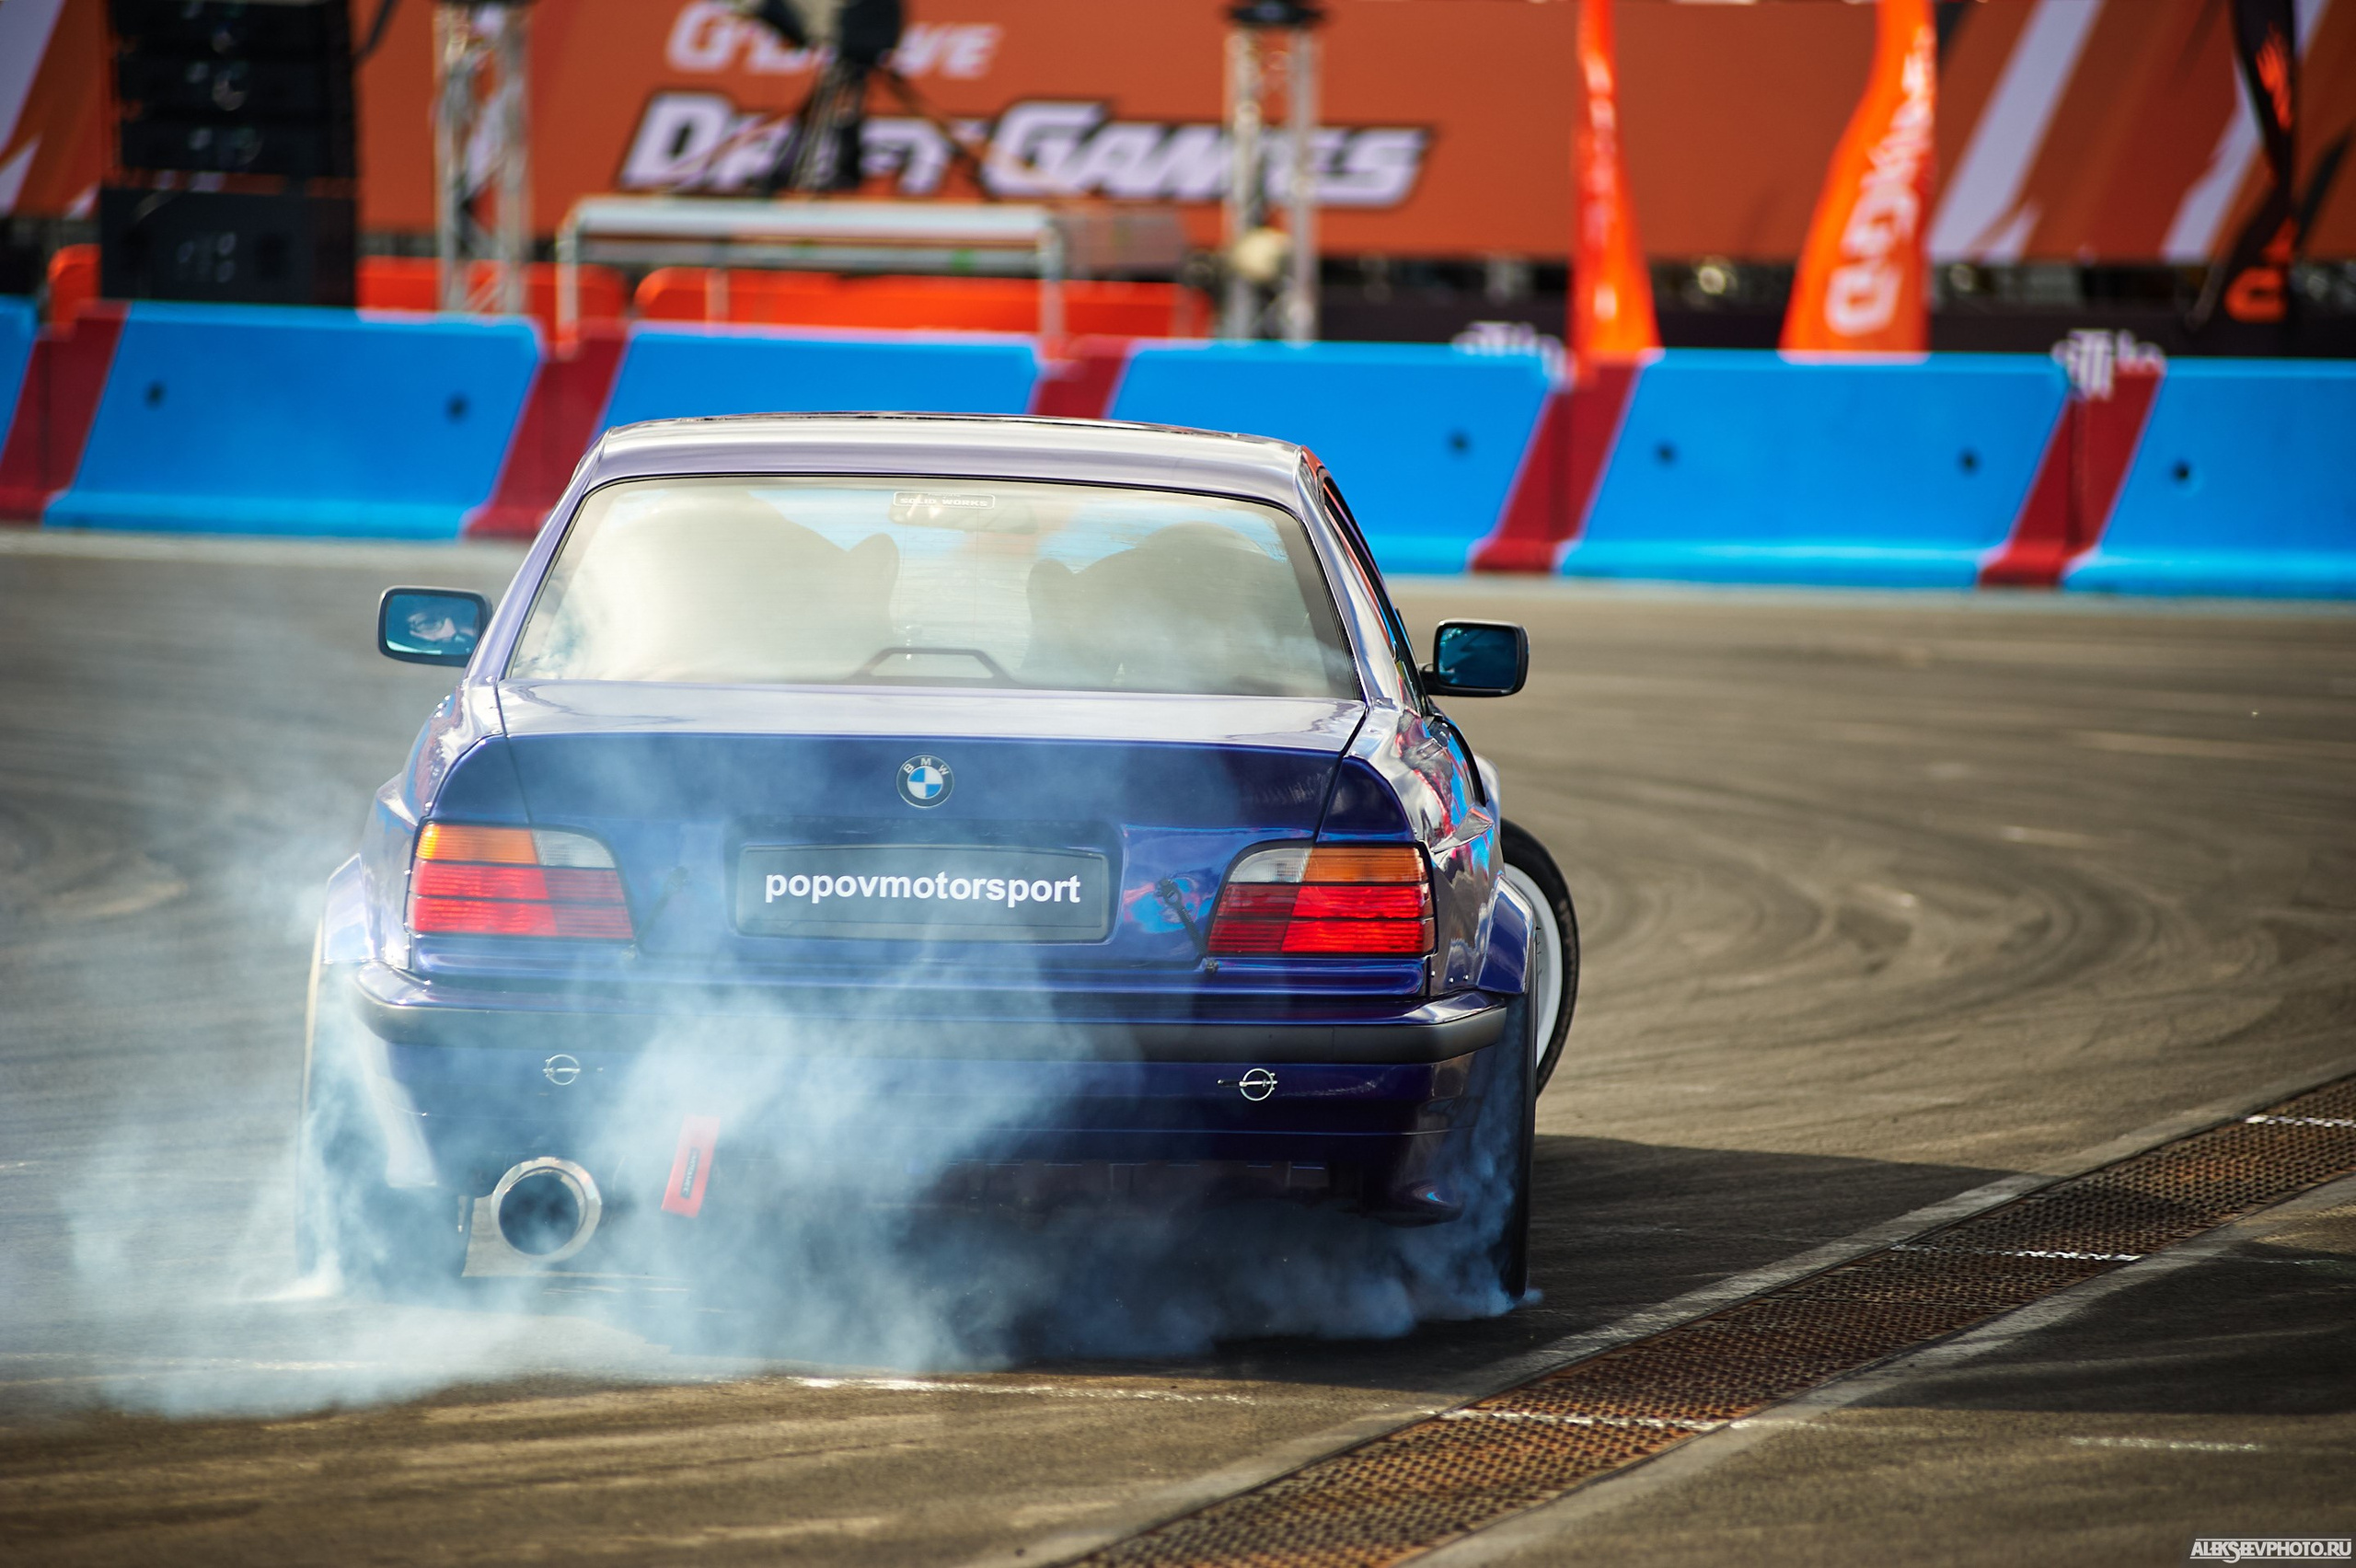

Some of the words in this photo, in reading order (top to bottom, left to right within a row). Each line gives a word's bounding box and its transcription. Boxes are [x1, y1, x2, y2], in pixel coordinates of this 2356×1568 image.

[622, 93, 992, 195] DRFT
[899, 497, 938, 505] SOLID
[941, 498, 988, 507] WORKS
[903, 757, 950, 776] BMW
[765, 870, 1080, 908] popovmotorsport
